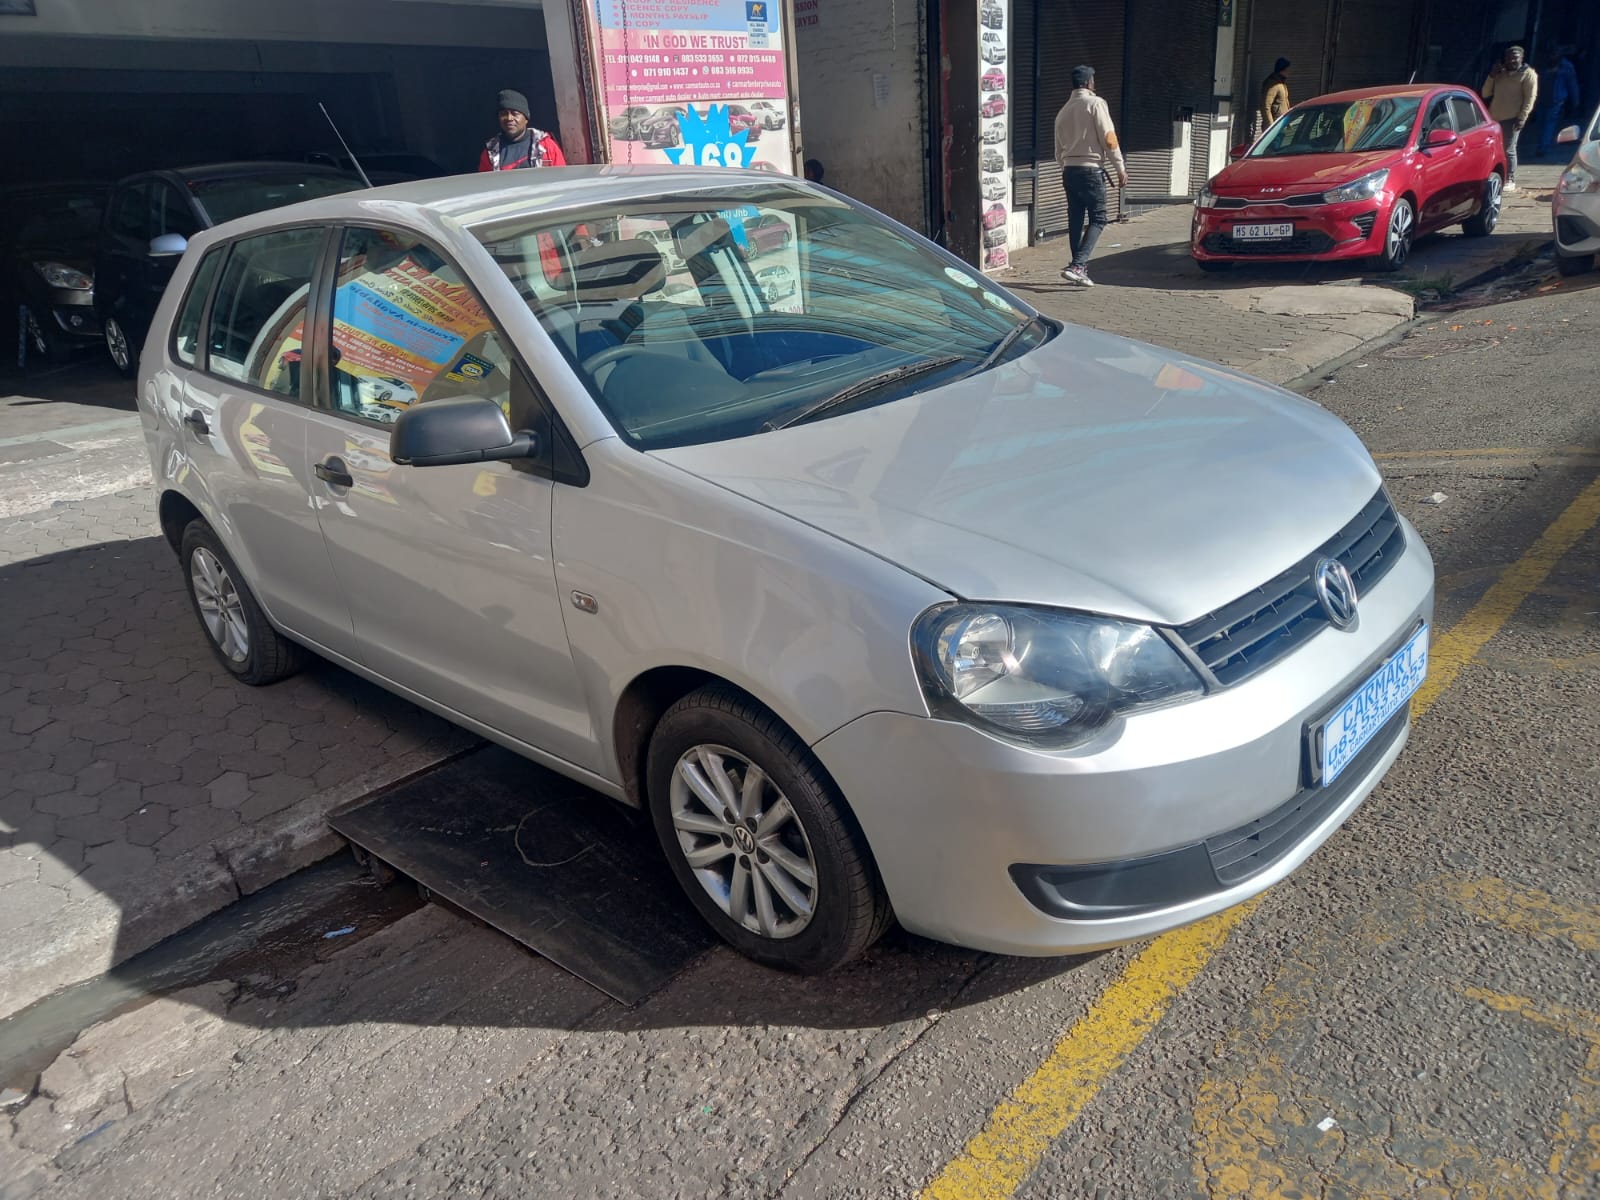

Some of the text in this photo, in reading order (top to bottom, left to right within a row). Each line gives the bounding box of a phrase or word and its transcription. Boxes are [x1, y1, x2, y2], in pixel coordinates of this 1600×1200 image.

[663, 35, 687, 48] GOD
[690, 35, 707, 48] WE
[643, 67, 657, 77] 071
[657, 67, 671, 77] 910
[1249, 225, 1260, 237] 62
[1279, 224, 1291, 235] GP
[1344, 642, 1414, 731] CARMART
[1329, 651, 1425, 765] 083 533 3653
